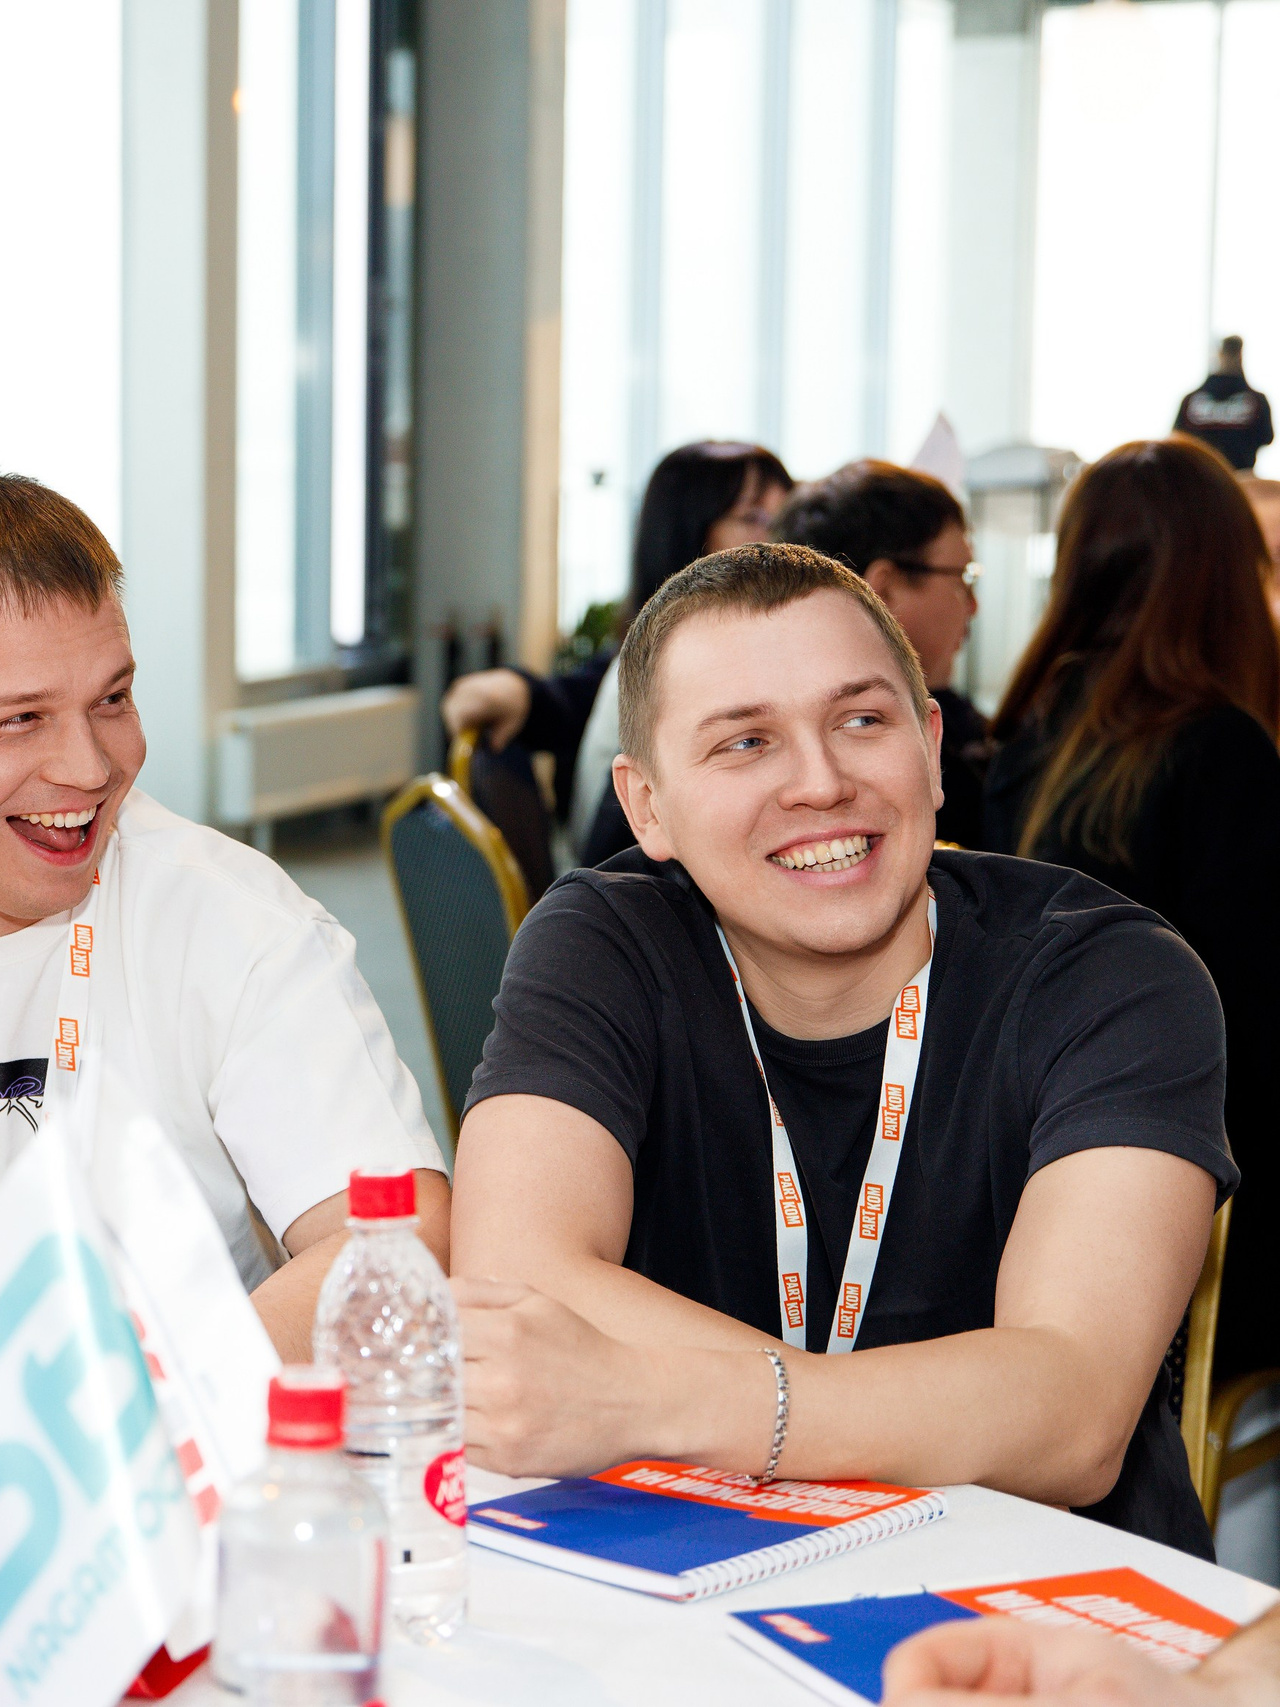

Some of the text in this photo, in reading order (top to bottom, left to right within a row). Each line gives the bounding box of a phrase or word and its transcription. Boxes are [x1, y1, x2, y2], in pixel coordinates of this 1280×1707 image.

[72, 926, 92, 976] PART KOM
[897, 986, 919, 1038] PART KOM
[57, 1019, 78, 1070] PART KOM
[883, 1085, 903, 1138] PART KOM
[779, 1174, 802, 1226] PART KOM
[861, 1185, 882, 1239] PART KOM
[784, 1275, 803, 1326] PART KOM
[839, 1285, 860, 1336] PART KOM
